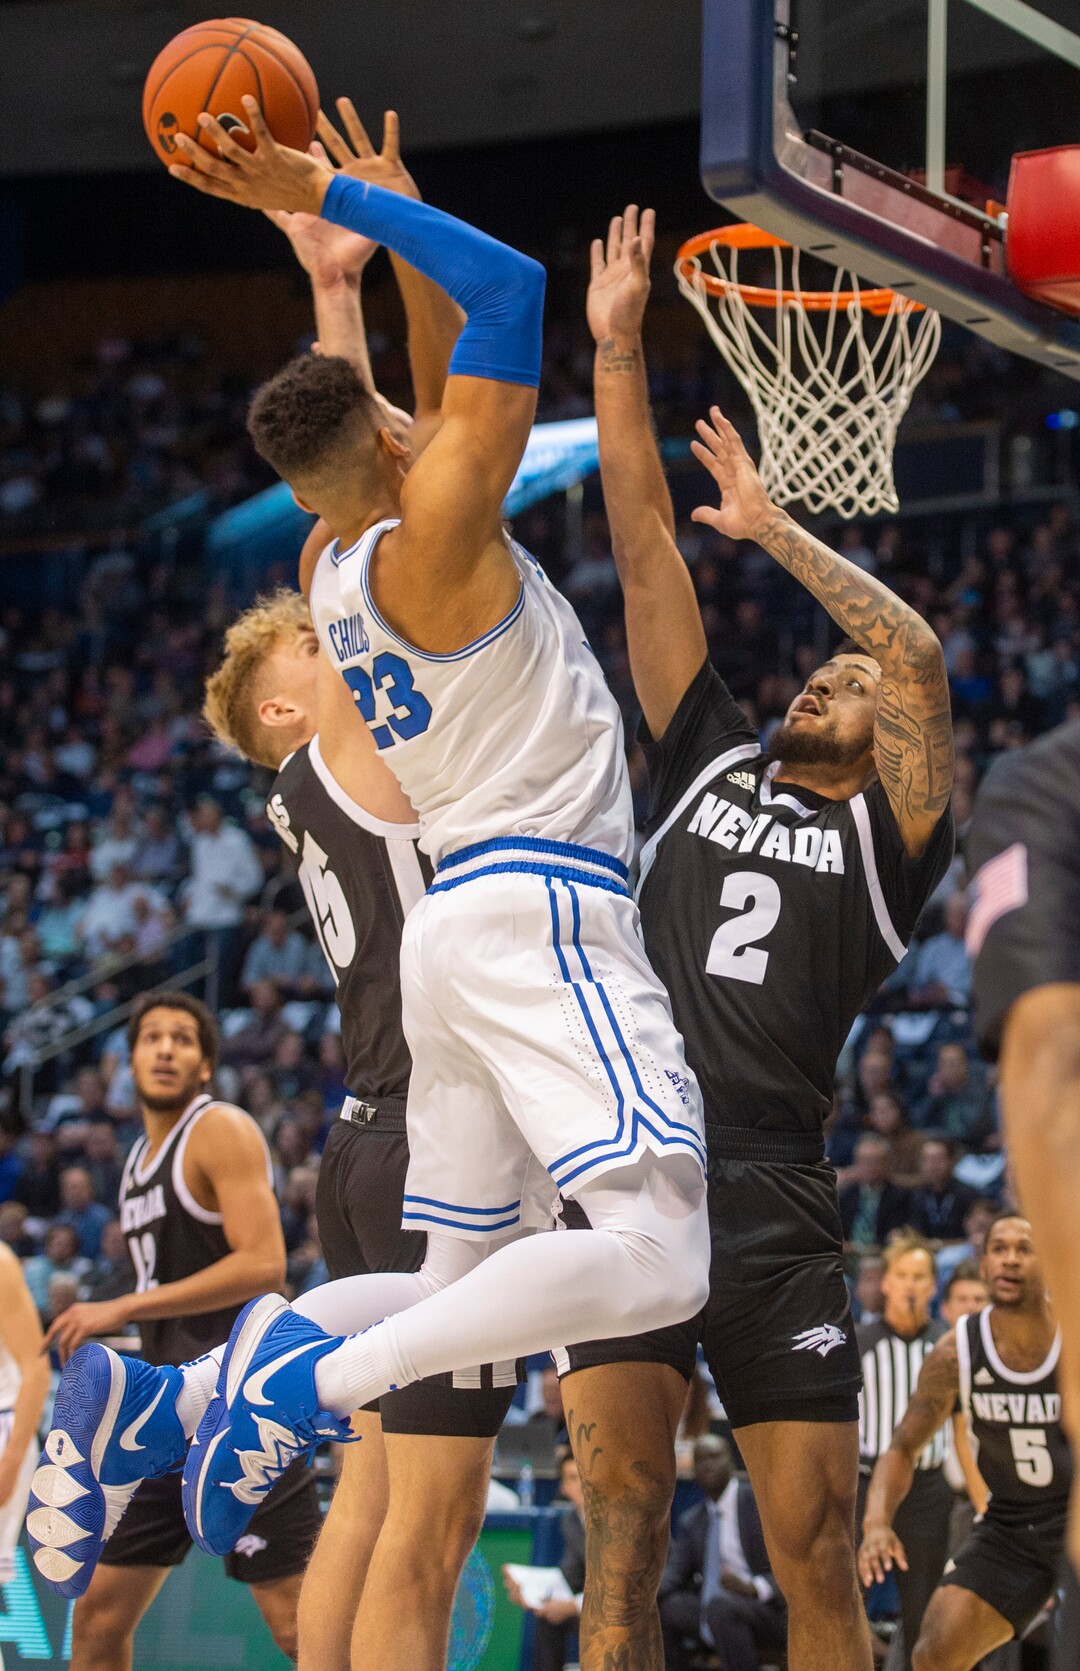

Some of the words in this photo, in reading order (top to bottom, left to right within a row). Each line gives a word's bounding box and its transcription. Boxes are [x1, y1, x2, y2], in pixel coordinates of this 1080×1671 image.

[328, 612, 370, 662] CHILDS
[342, 651, 432, 750] 23
[687, 791, 845, 875] NEVADA
[298, 829, 357, 988] 15
[705, 871, 781, 985] 2
[971, 1392, 1061, 1424] NEVAD
[1009, 1428, 1054, 1487] 5
